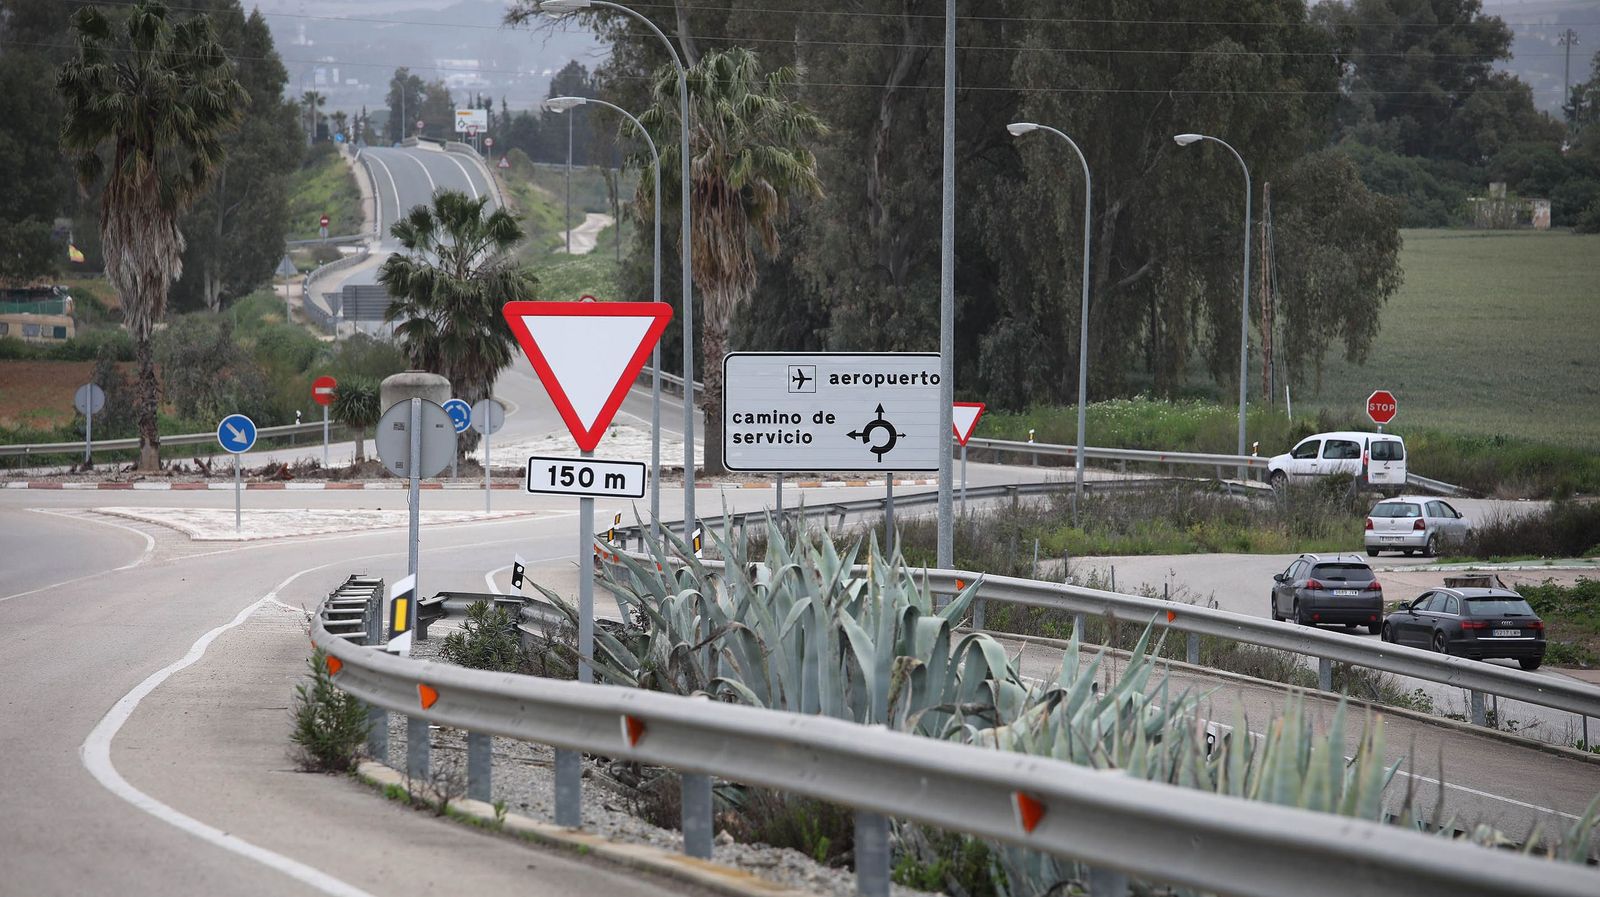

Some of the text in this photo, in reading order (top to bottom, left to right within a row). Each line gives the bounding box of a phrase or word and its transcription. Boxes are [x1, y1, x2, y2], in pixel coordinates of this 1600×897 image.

[829, 370, 941, 388] aeropuerto
[1369, 403, 1395, 412] STOP
[732, 409, 836, 425] camino de
[732, 429, 813, 444] servicio
[548, 465, 626, 490] 150 m
